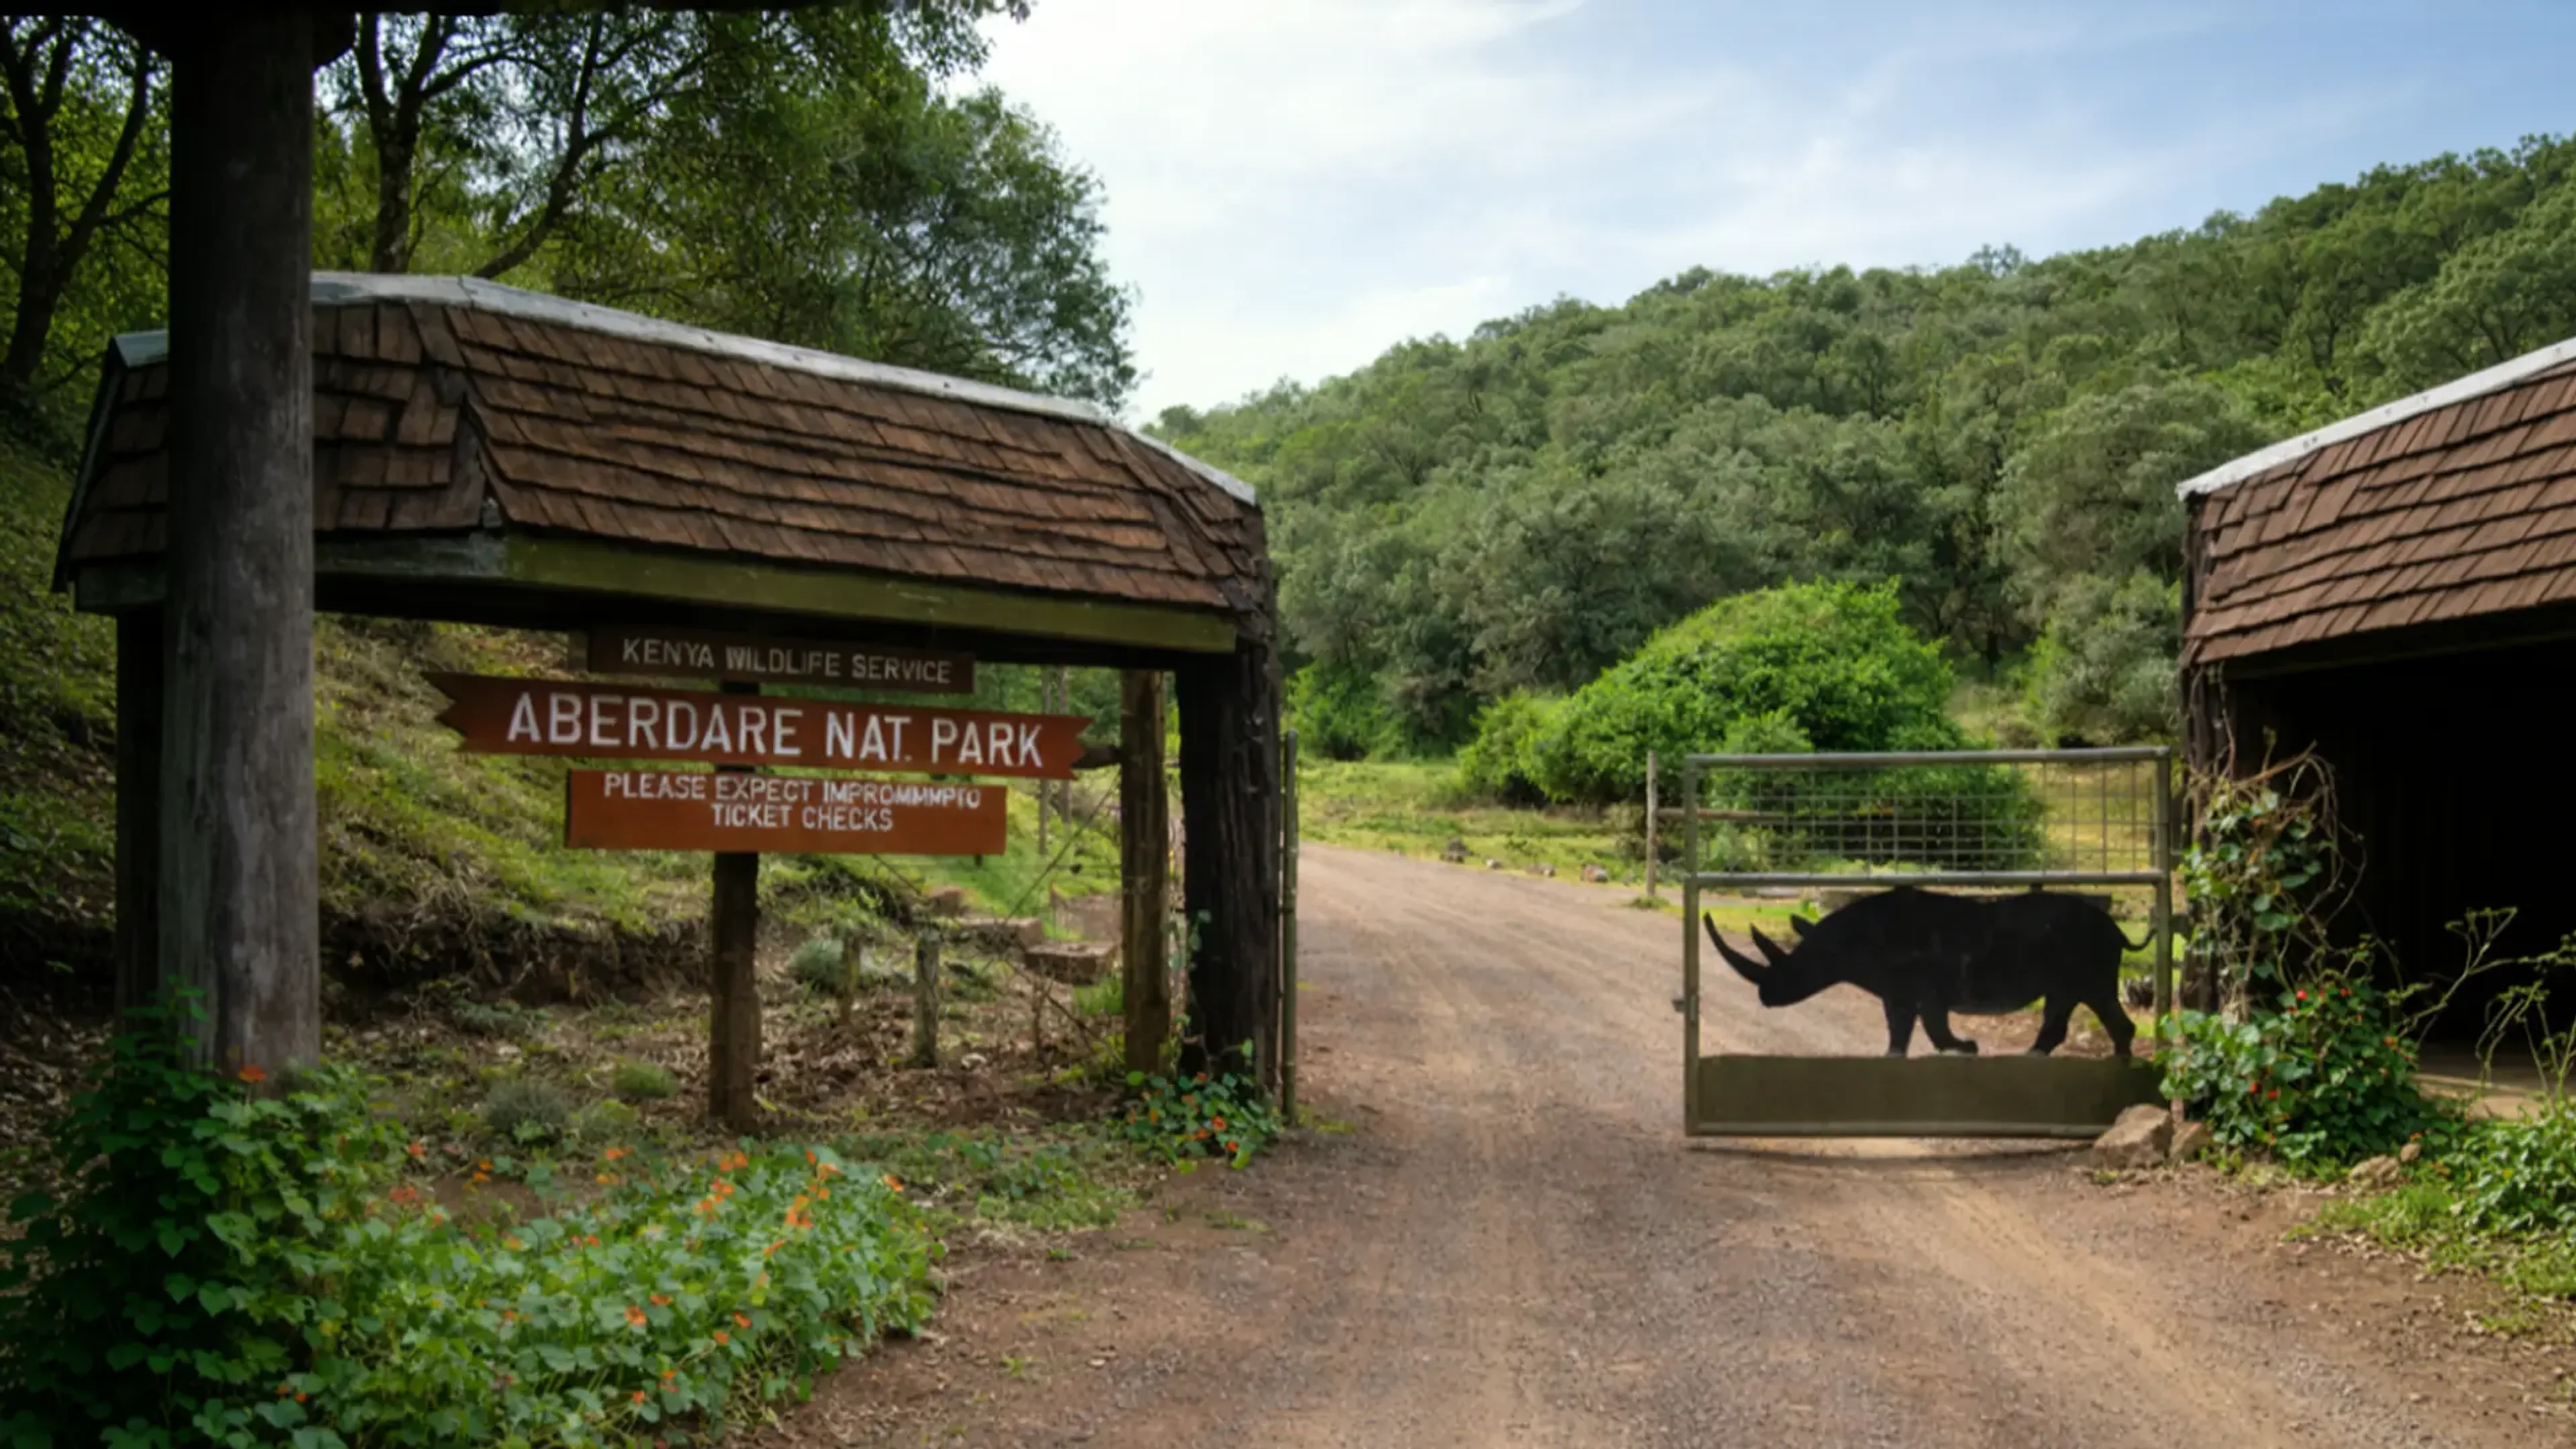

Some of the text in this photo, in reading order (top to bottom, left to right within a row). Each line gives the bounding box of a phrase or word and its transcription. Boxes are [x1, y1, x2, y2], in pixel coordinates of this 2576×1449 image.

[623, 637, 951, 684] KENYA WILDLIFE SERVICE
[506, 692, 1044, 768] ABERDARE NAT. PARK
[604, 773, 707, 800] PLEASE
[715, 775, 813, 802] EXPECT
[711, 804, 894, 832] TICKET CHECKS
